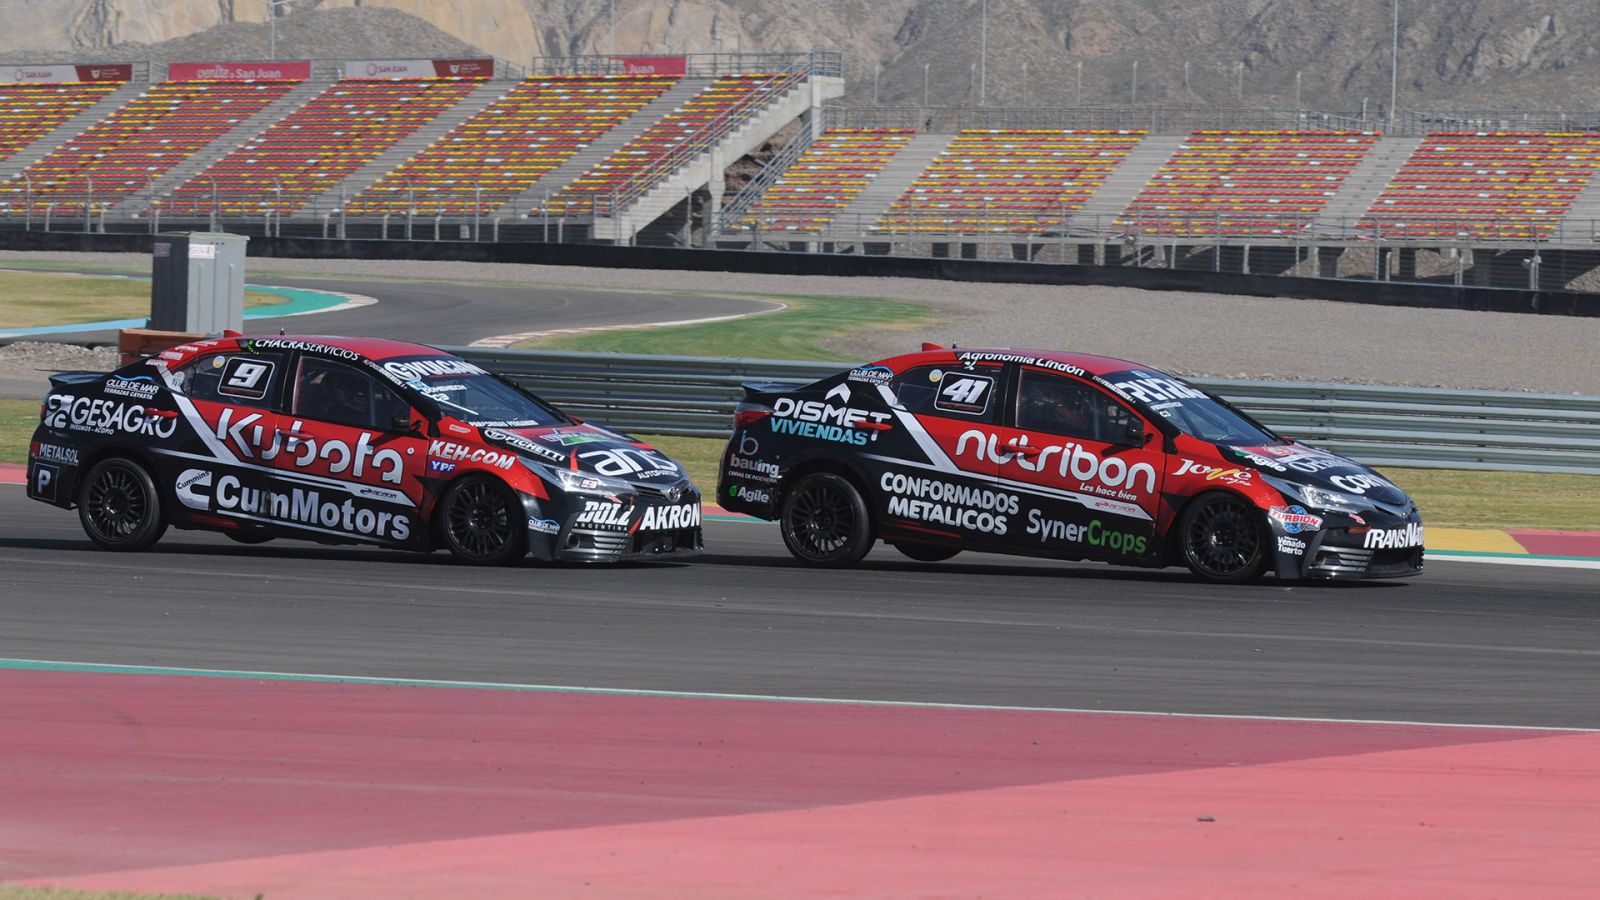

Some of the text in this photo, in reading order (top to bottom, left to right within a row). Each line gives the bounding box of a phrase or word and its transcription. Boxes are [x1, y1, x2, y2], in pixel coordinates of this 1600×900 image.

[236, 68, 254, 78] San
[258, 68, 281, 78] Juan
[106, 379, 159, 394] CLUB DE MAR
[227, 362, 267, 388] 9
[942, 378, 988, 403] 41
[70, 398, 176, 439] GESAGRO
[773, 398, 891, 441] DISMET
[771, 417, 868, 446] VIVIENDAS
[39, 443, 79, 463] METALSOL
[216, 408, 403, 485] Kubota
[429, 439, 516, 470] KEH-COM
[505, 436, 566, 461] PICHETTI
[431, 460, 456, 472] YPF
[731, 454, 780, 478] bauing
[956, 430, 1156, 494] nutribon
[1244, 455, 1287, 472] Agile
[38, 469, 51, 493] P
[176, 470, 210, 490] Cummins
[1080, 481, 1137, 501] Les hace bien
[738, 487, 769, 502] Agile
[880, 471, 1019, 515] CONFORMADOS
[215, 475, 410, 541] CumMotors
[576, 501, 635, 525] DOLZ
[639, 503, 700, 531] AKRON
[888, 497, 1008, 535] METALICOS
[1272, 511, 1318, 525] TURBION
[574, 523, 628, 531] ARGENTINA
[1026, 509, 1146, 554] SynerCrops
[1278, 536, 1305, 549] Venado
[1278, 544, 1302, 555] Tuerto
